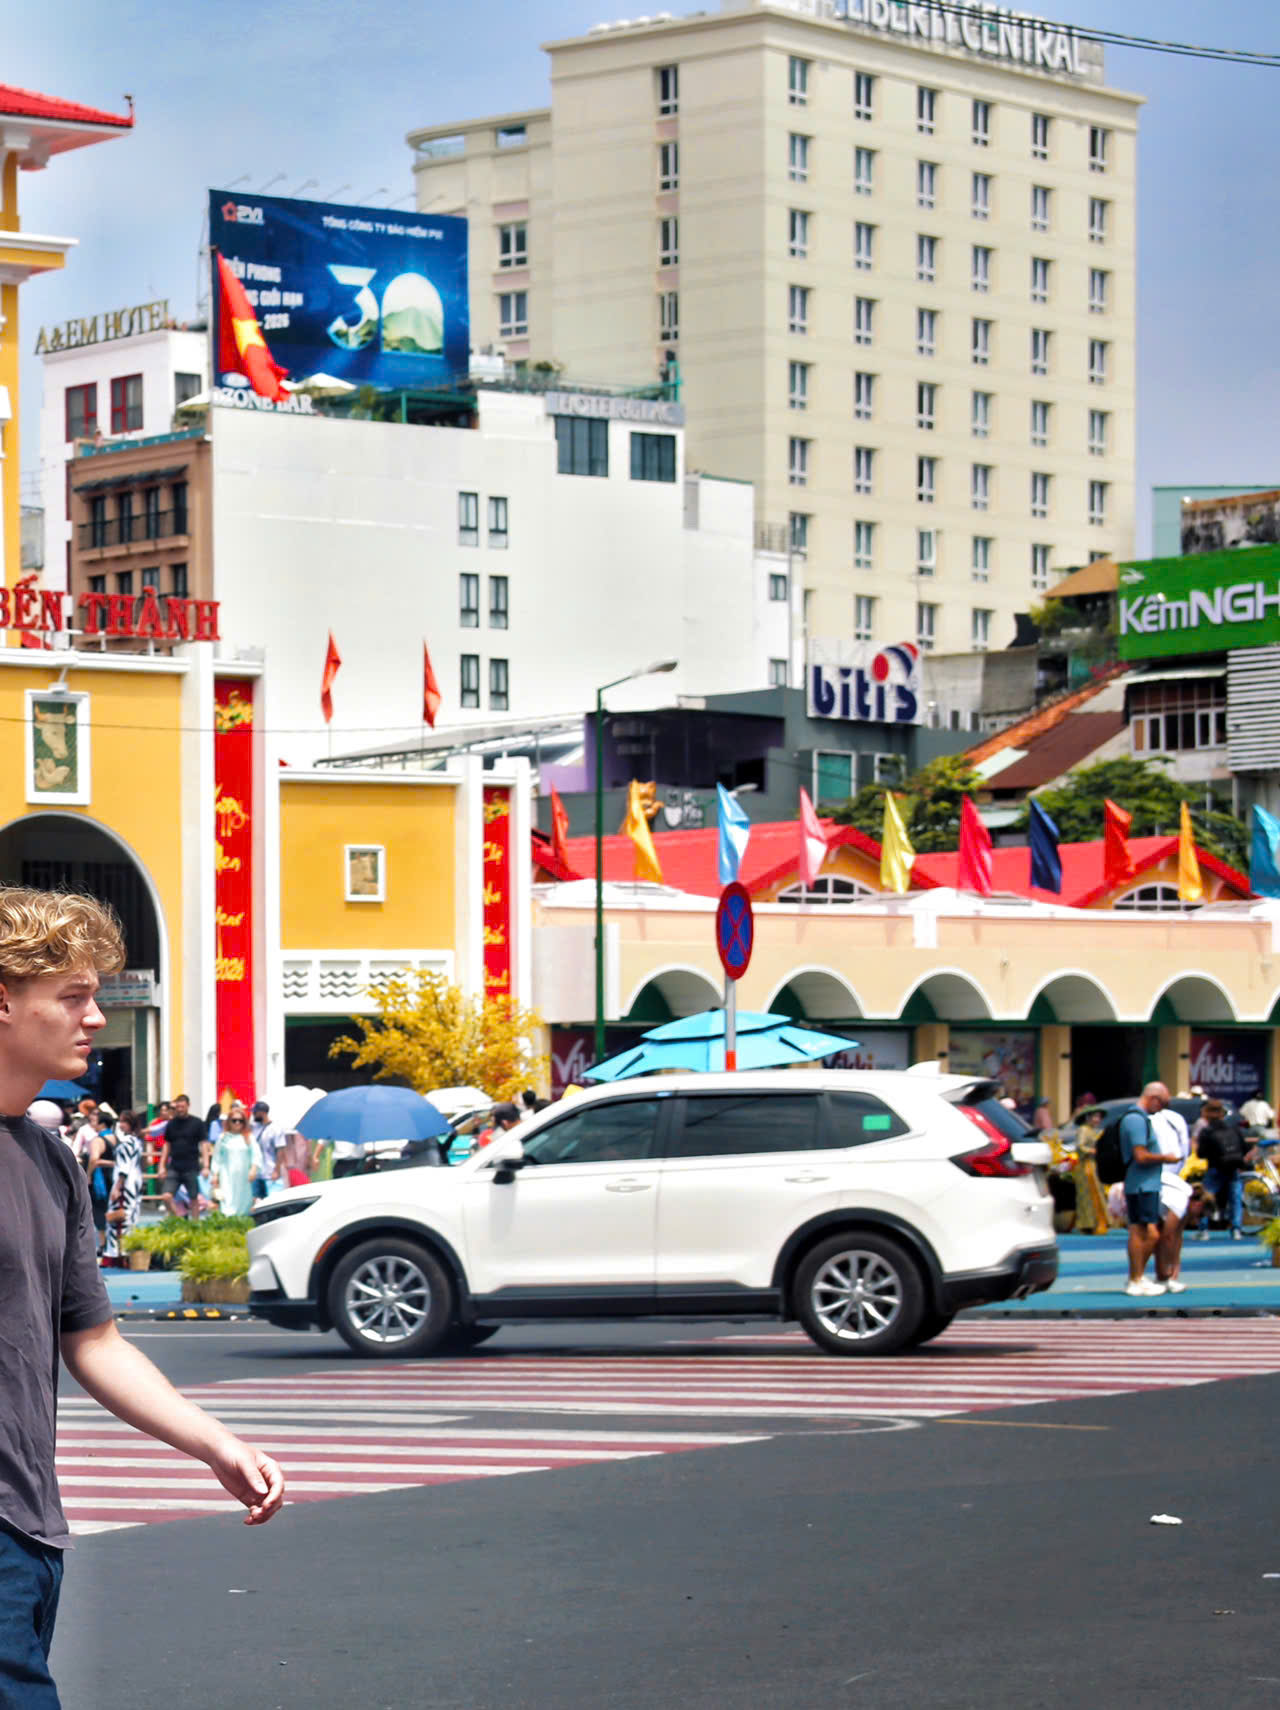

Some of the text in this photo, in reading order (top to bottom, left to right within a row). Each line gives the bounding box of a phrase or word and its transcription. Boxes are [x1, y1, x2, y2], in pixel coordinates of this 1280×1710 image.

[959, 8, 1088, 74] CENTRAL
[34, 299, 169, 355] A&EM HOTEL
[78, 585, 221, 641] THÀNH
